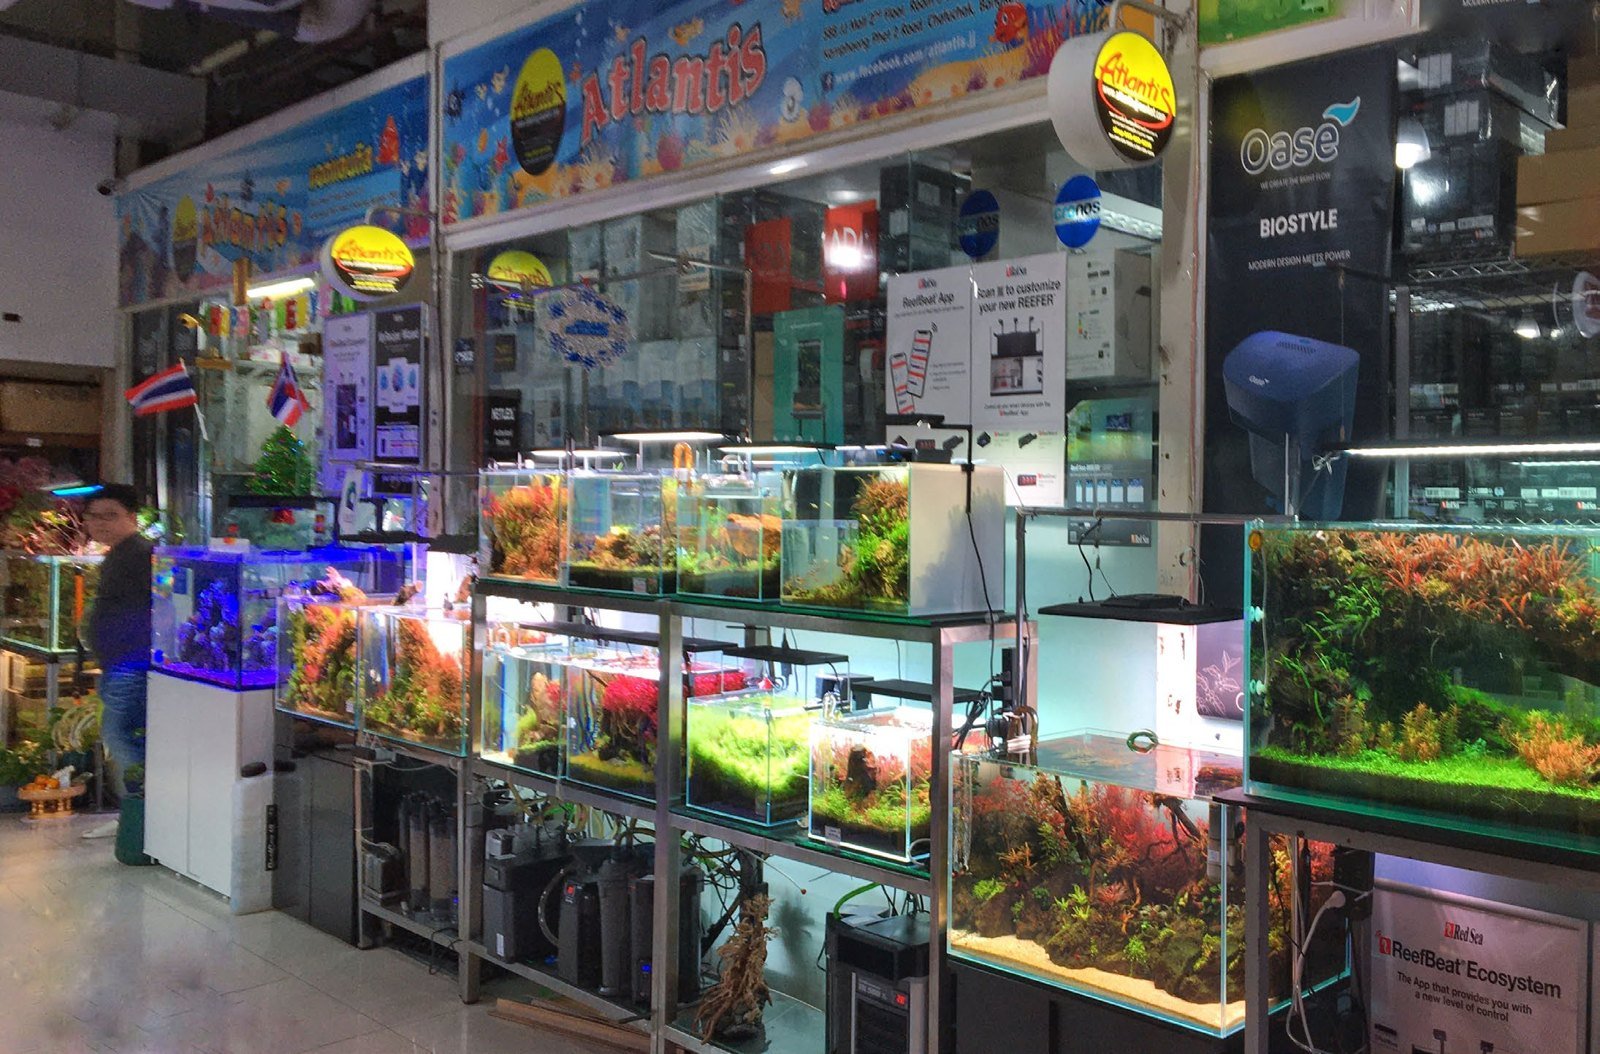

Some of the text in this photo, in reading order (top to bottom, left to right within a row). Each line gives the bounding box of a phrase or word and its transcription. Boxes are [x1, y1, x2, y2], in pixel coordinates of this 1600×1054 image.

[580, 21, 767, 148] Atlantis
[1099, 51, 1170, 102] Atlantis
[1240, 122, 1340, 175] Oase
[1259, 208, 1338, 239] BIOSTYLE
[1276, 253, 1302, 267] DESIGN
[1325, 249, 1351, 262] POWER
[938, 291, 955, 306] App
[1016, 279, 1062, 295] customize
[978, 301, 997, 316] your
[999, 299, 1016, 311] new
[1017, 294, 1055, 309] REEFER
[1453, 924, 1484, 945] Red Sea
[1397, 971, 1532, 1015] The App that provides you with
[1466, 959, 1562, 999] Ecosystem
[1414, 992, 1509, 1022] a new level of control
